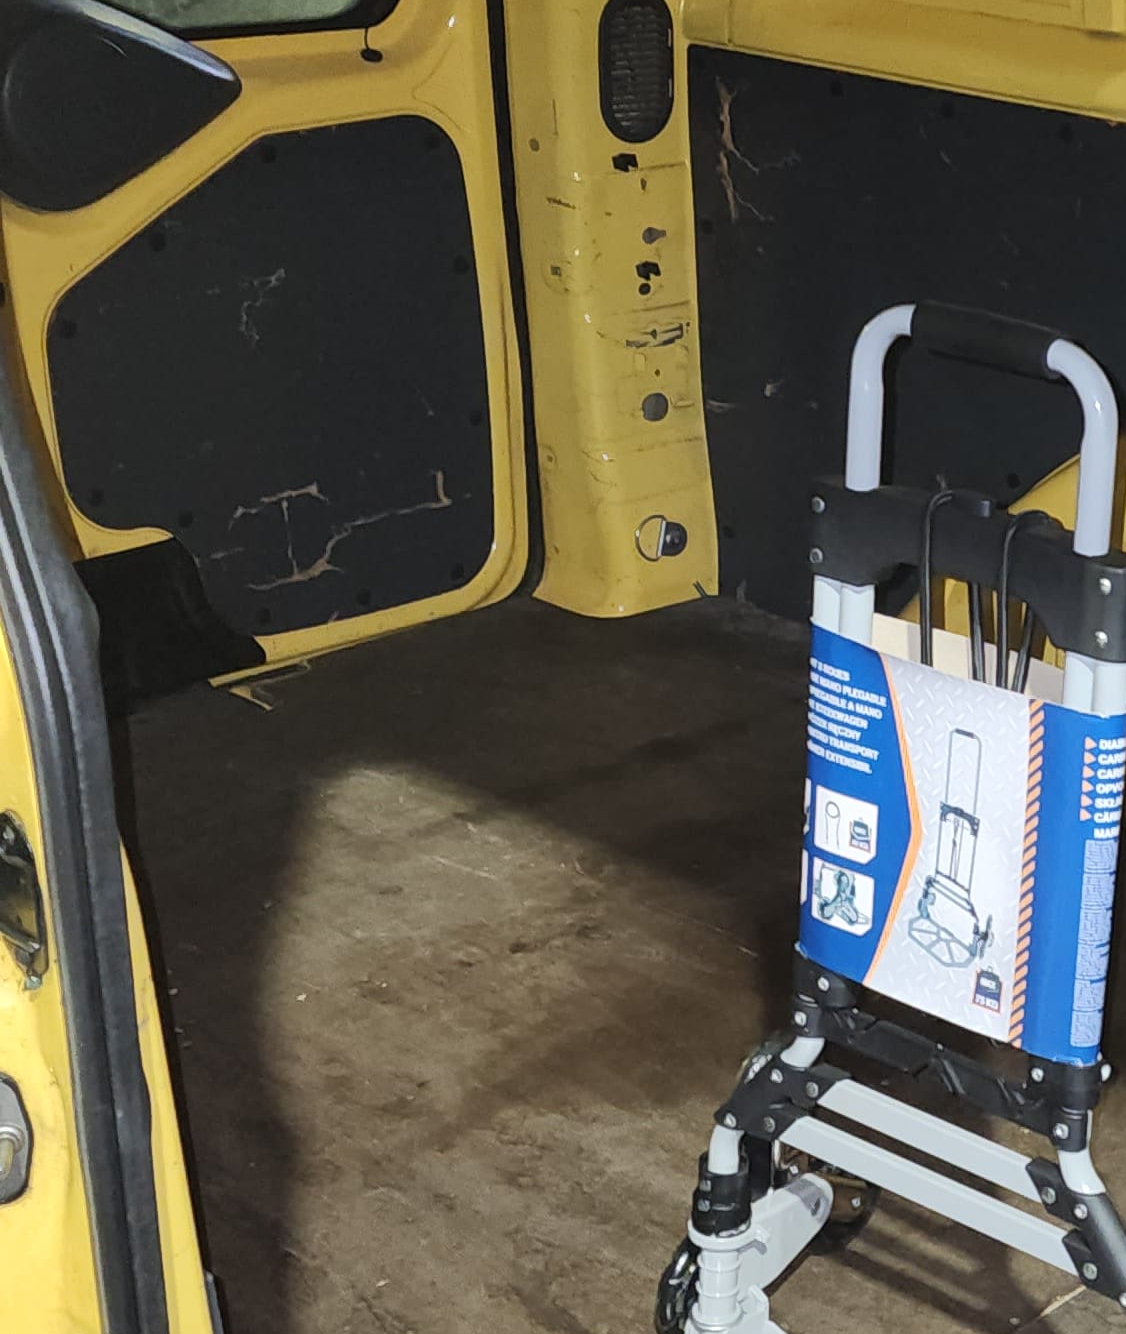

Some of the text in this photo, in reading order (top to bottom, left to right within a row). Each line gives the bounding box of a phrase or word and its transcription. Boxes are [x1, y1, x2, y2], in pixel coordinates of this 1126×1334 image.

[842, 684, 887, 707] PLEGABLE
[847, 700, 855, 712] A
[856, 702, 883, 719] MANO
[829, 736, 880, 761] TRANSPORT
